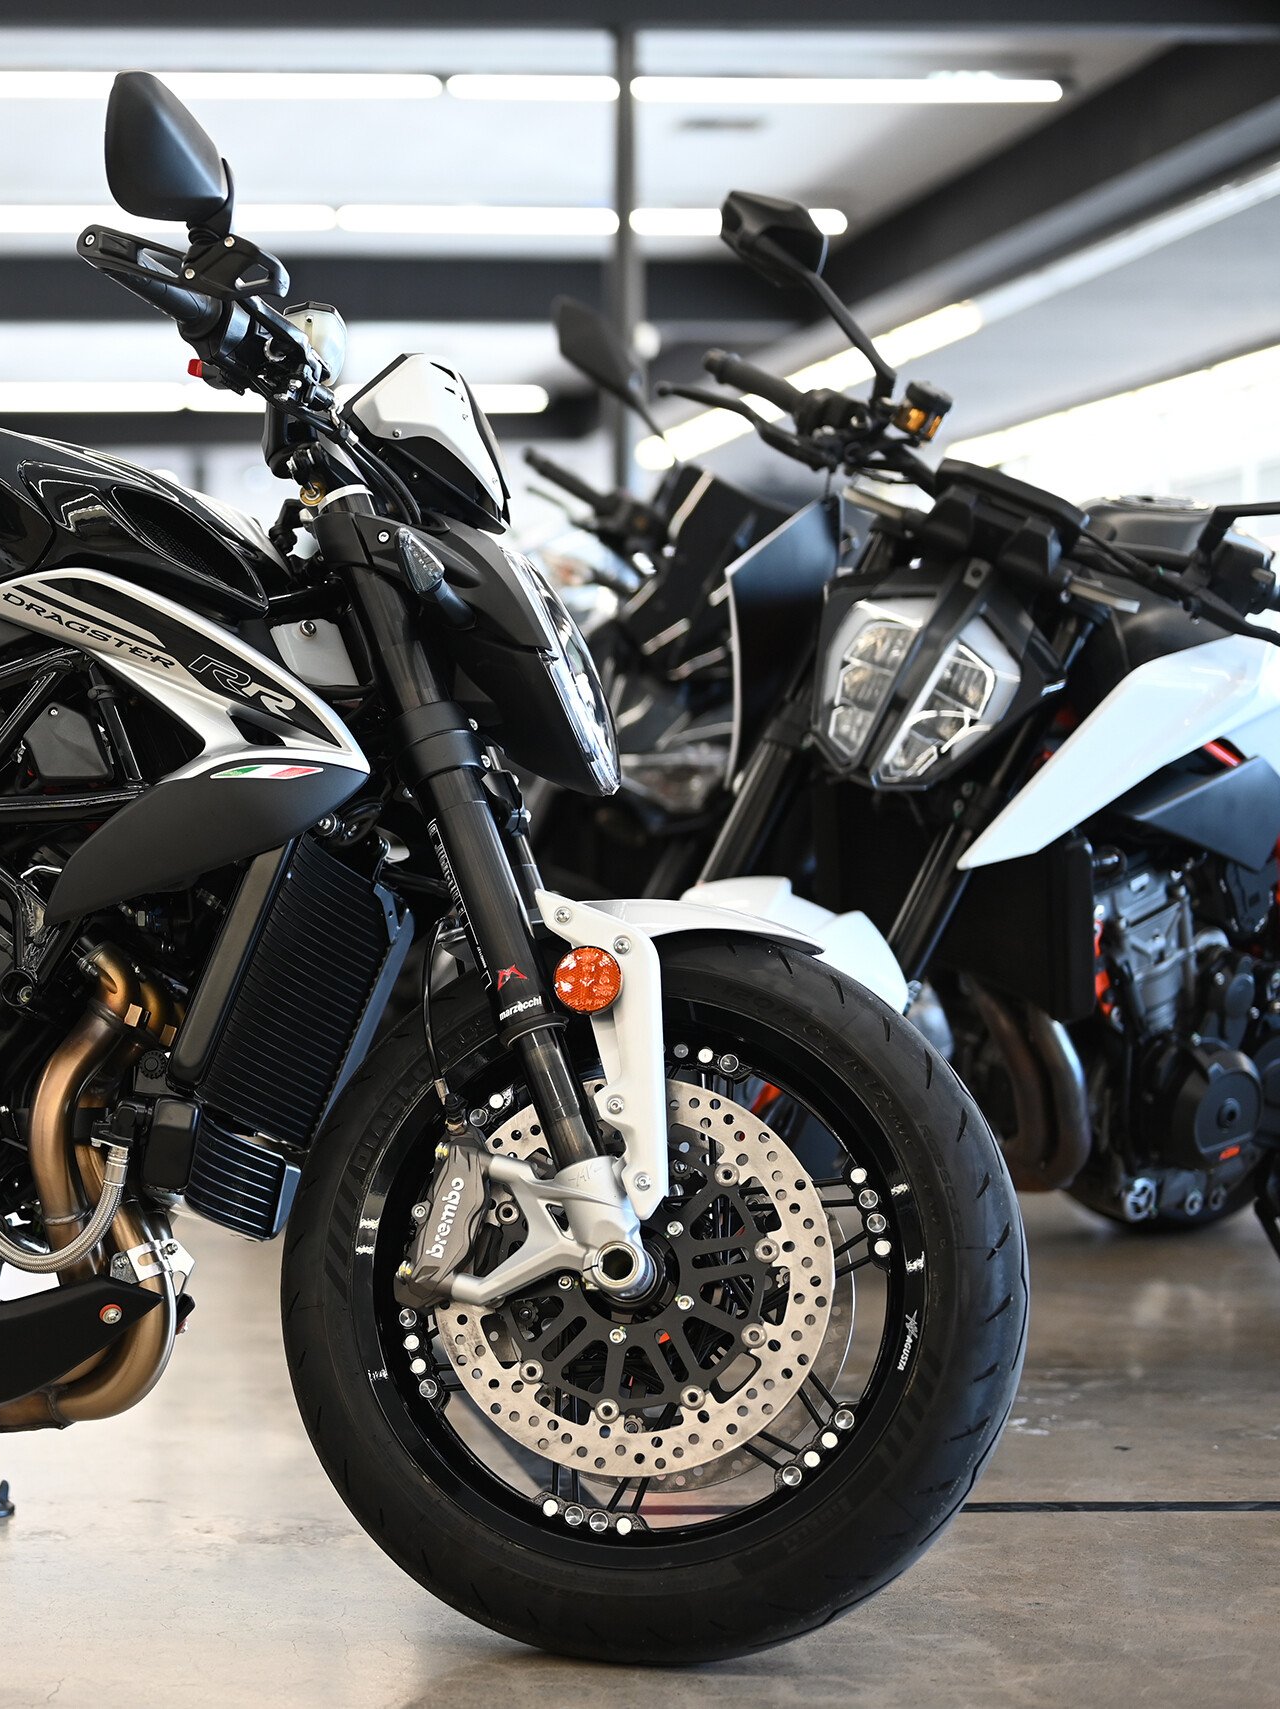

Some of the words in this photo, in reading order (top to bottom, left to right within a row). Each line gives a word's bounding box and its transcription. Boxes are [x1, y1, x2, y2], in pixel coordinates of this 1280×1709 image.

[2, 592, 176, 669] DRAGSTER
[188, 653, 296, 722] RR
[499, 995, 542, 1021] marzocchi
[425, 1177, 465, 1259] brembo
[897, 1335, 912, 1371] AGUSTA
